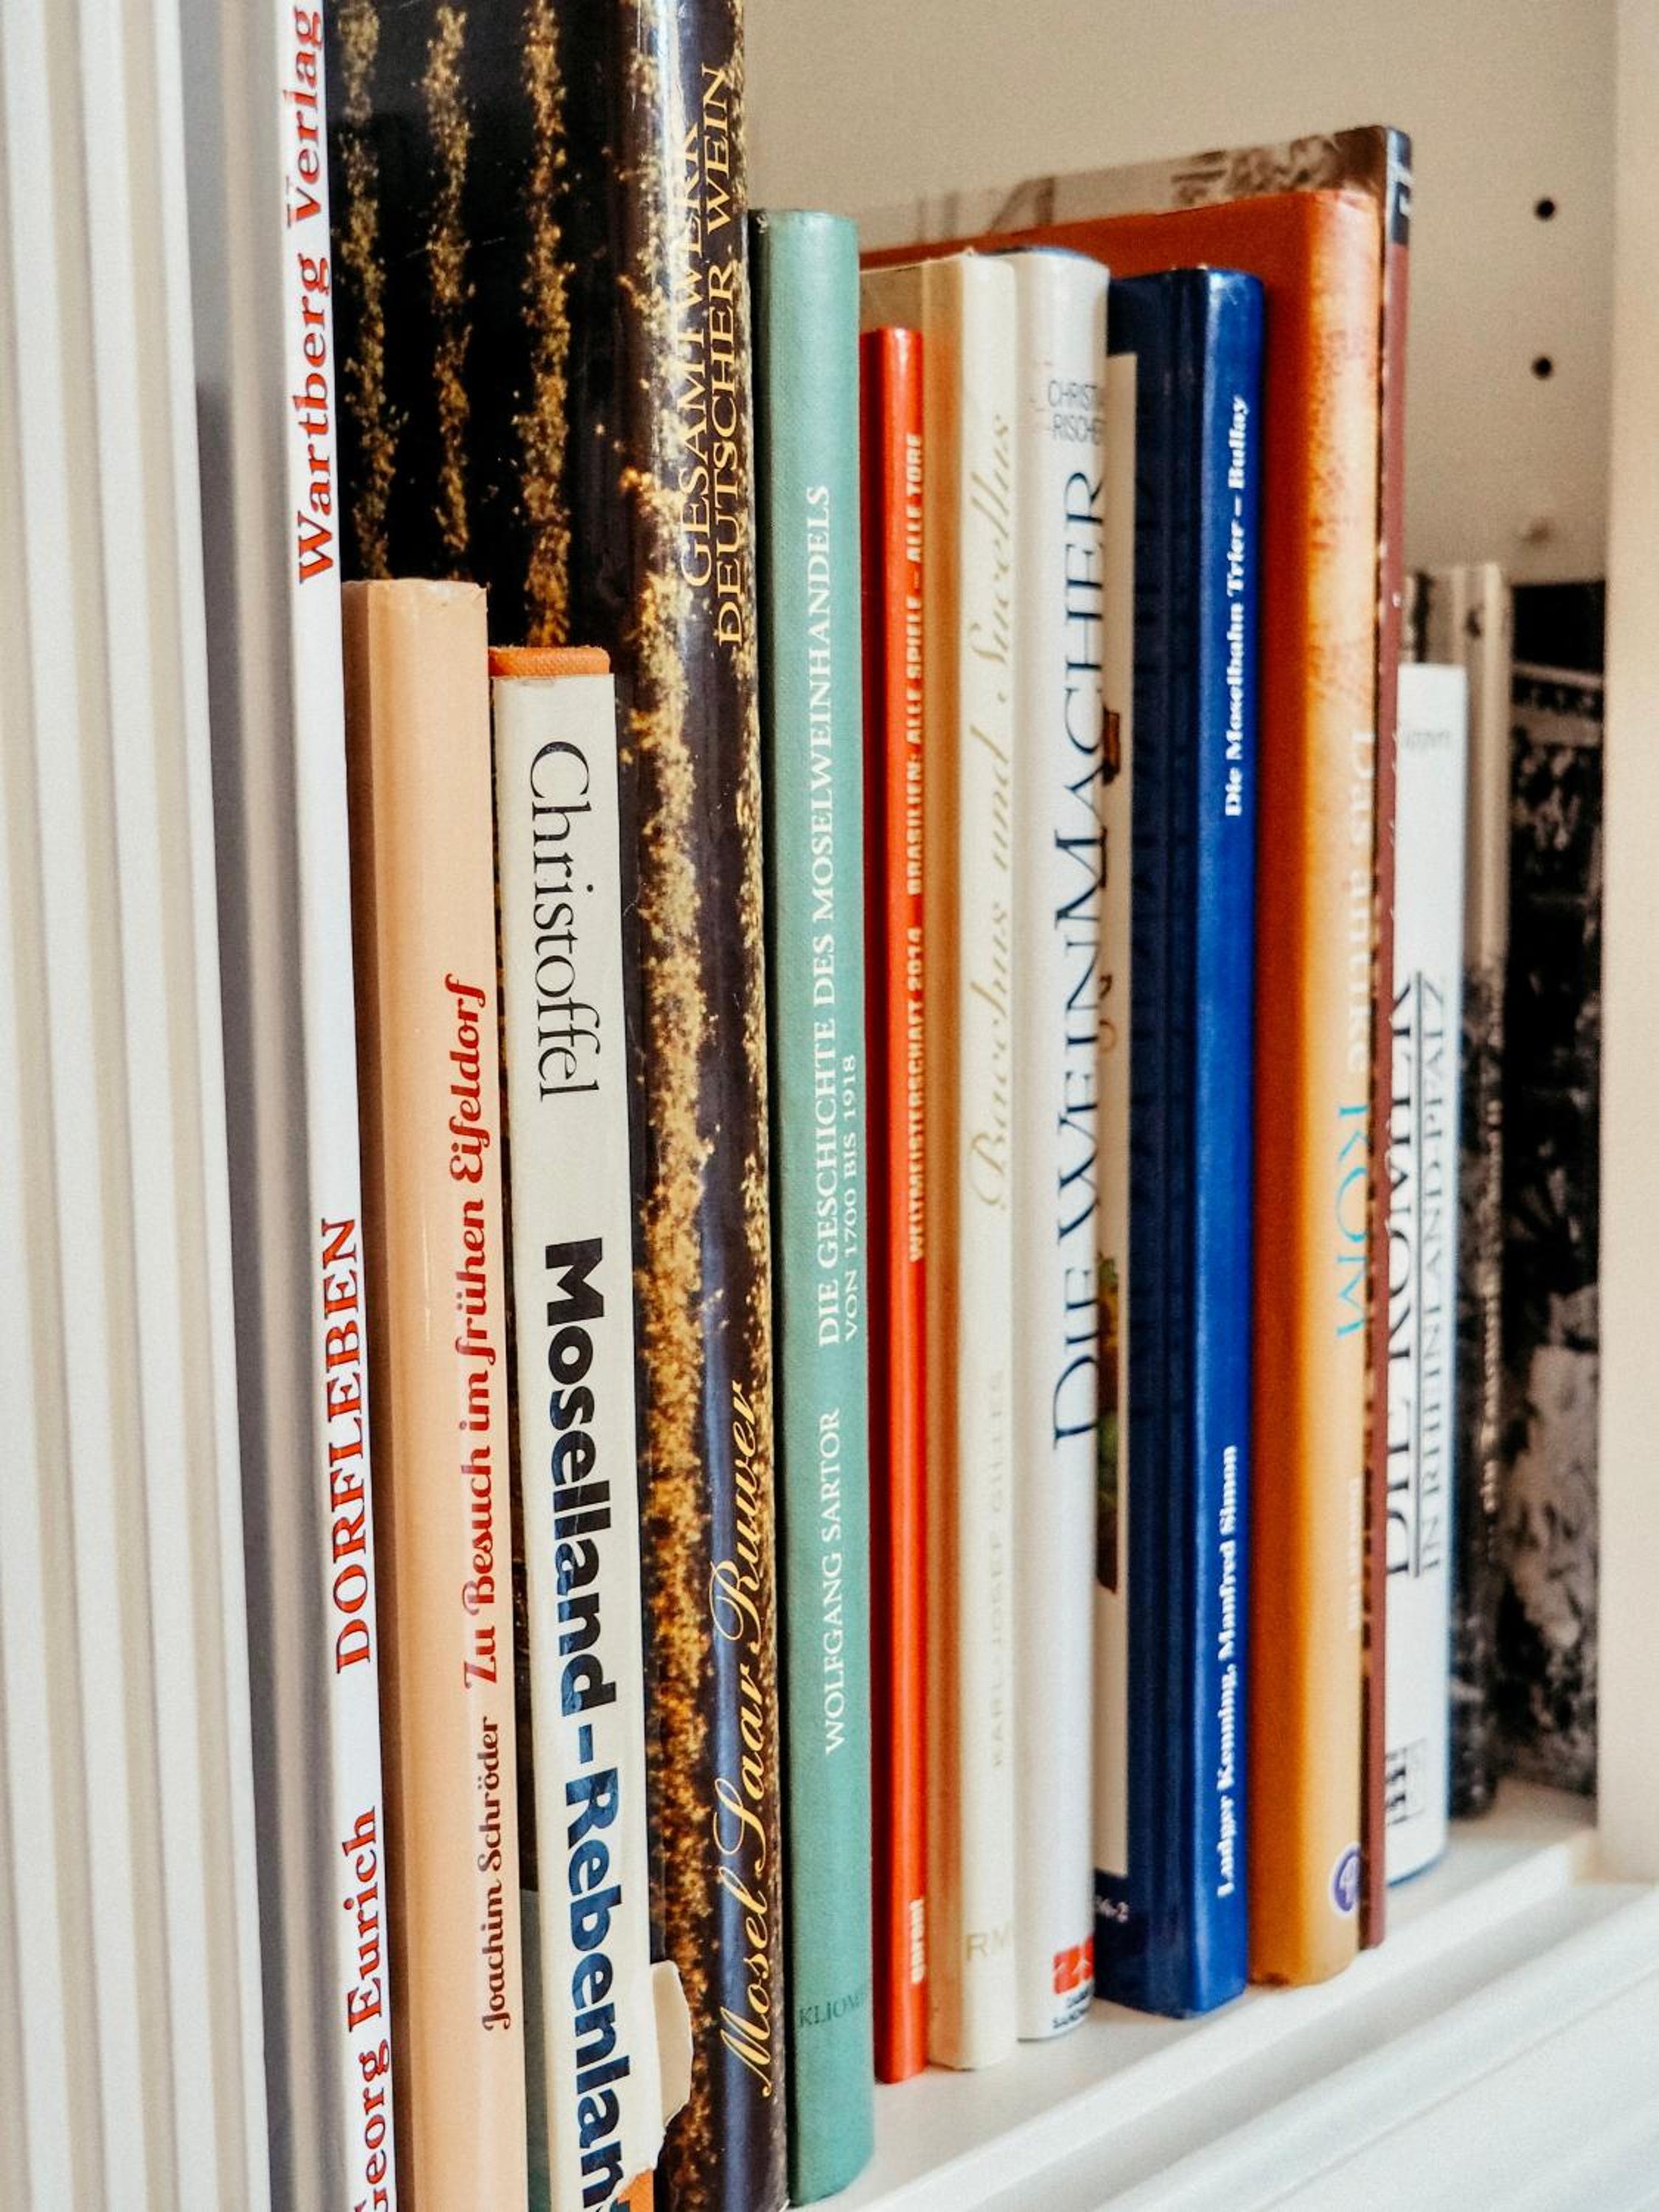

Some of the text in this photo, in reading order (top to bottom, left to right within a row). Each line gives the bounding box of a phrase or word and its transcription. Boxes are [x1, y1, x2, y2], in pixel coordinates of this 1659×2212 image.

[282, 4, 335, 582] Wartberg Verlag
[673, 121, 714, 587] GESAMTWERK
[700, 61, 742, 646] DEUTSCHER WEIN
[1227, 394, 1249, 489] Bullay
[1225, 519, 1245, 596] Trier
[1225, 602, 1244, 759] Moselbahn
[529, 740, 600, 1102] Christoffel
[806, 484, 841, 1346] DIE GESCHICHTE DES MOSELWEINHANDELS
[1224, 767, 1244, 815] Die
[1052, 470, 1106, 1449] DIE WEINMACHER
[444, 972, 498, 1688] Zu Besuch im frühen Eifeldorf
[841, 1054, 859, 1342] VON 1700 BIS 1918
[321, 1217, 371, 1673] DORFLEBEN
[818, 1407, 846, 1753] WOLFGANG SARTOR
[1217, 1538, 1237, 1661] Manfred
[1219, 1444, 1238, 1536] Simon
[476, 1714, 512, 2031] Joachim Schröder
[709, 1378, 773, 2097] Mosel Saar Ruwer
[1215, 1795, 1237, 1898] Ludger
[341, 1805, 383, 2031] Eurich
